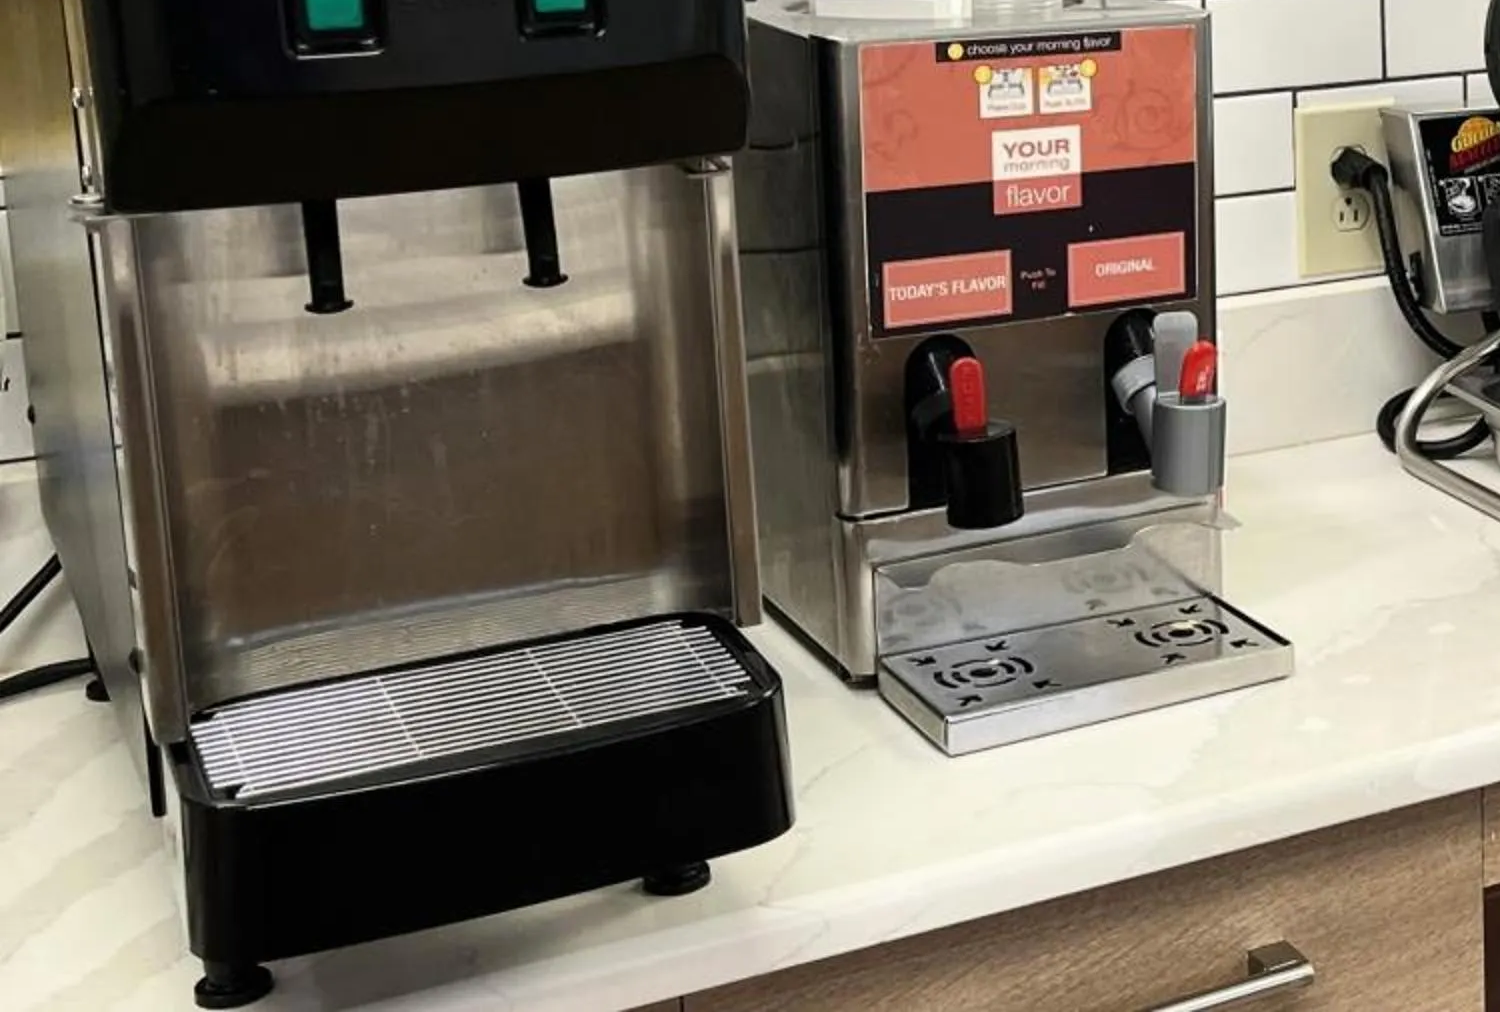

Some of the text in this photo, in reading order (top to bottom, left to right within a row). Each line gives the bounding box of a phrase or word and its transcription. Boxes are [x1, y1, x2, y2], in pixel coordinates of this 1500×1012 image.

[967, 36, 1113, 56] choose your morning flavor
[1003, 138, 1070, 158] YOUR
[1004, 157, 1070, 173] morning
[1006, 183, 1072, 207] flavor
[1095, 259, 1153, 277] ORIGINAL
[889, 274, 1006, 302] TODAY'S FLAVOR
